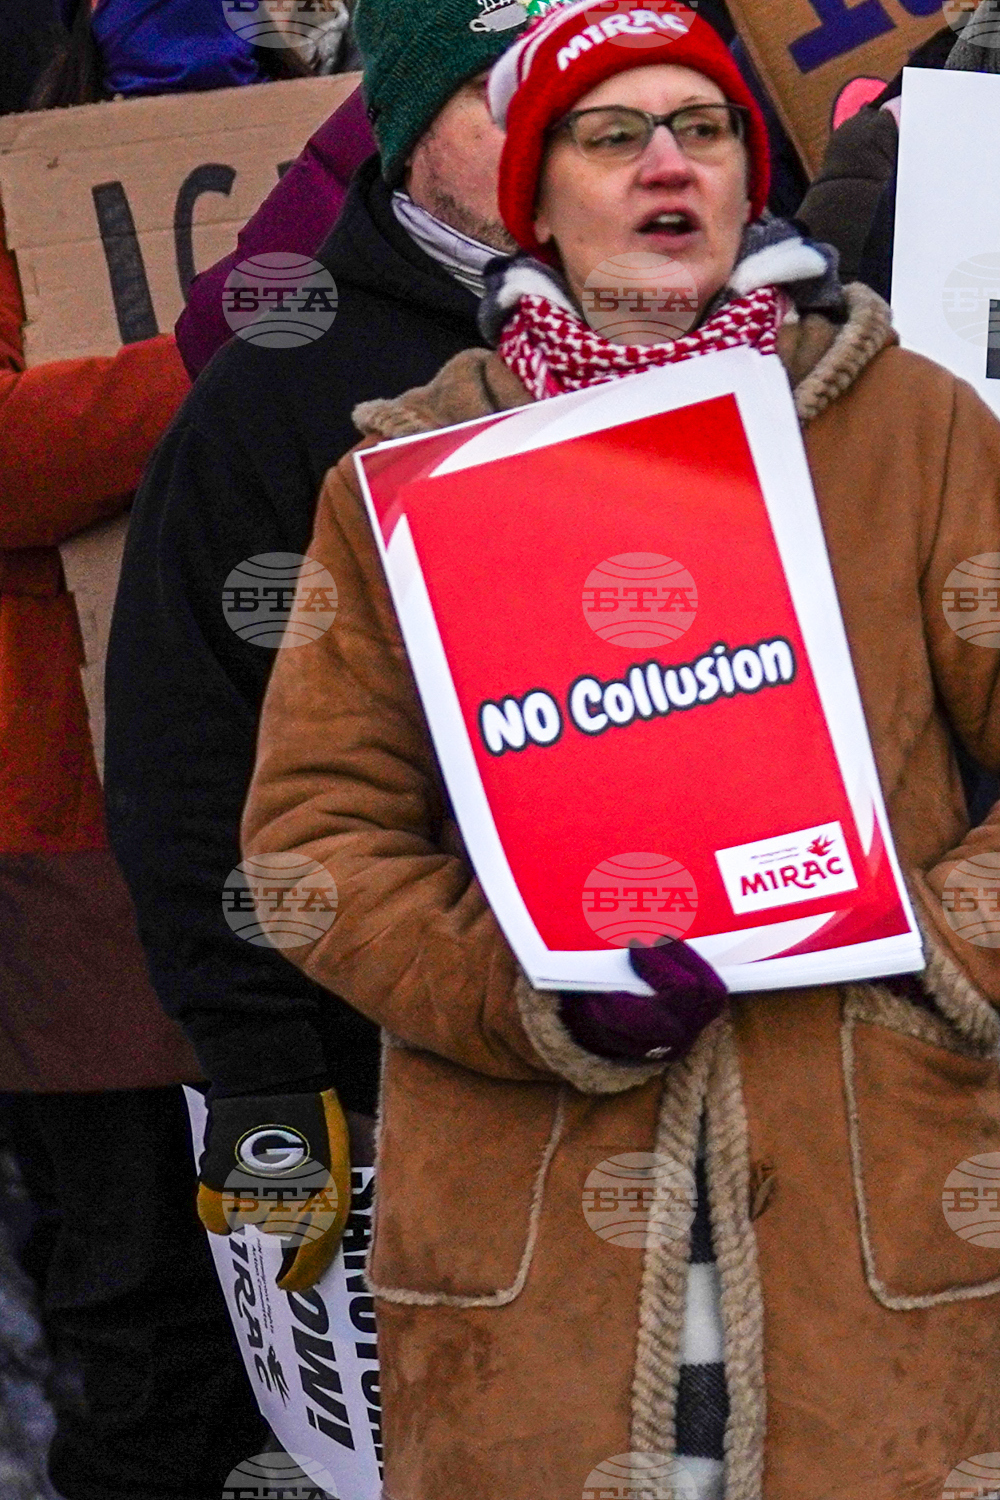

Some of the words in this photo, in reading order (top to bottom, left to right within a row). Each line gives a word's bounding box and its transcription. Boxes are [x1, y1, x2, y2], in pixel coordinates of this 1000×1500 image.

[556, 8, 690, 72] MIRAC
[91, 157, 300, 346] IC
[480, 692, 560, 751] NO
[571, 639, 793, 733] Collusion
[739, 856, 845, 897] MIRAC
[239, 1128, 305, 1170] G
